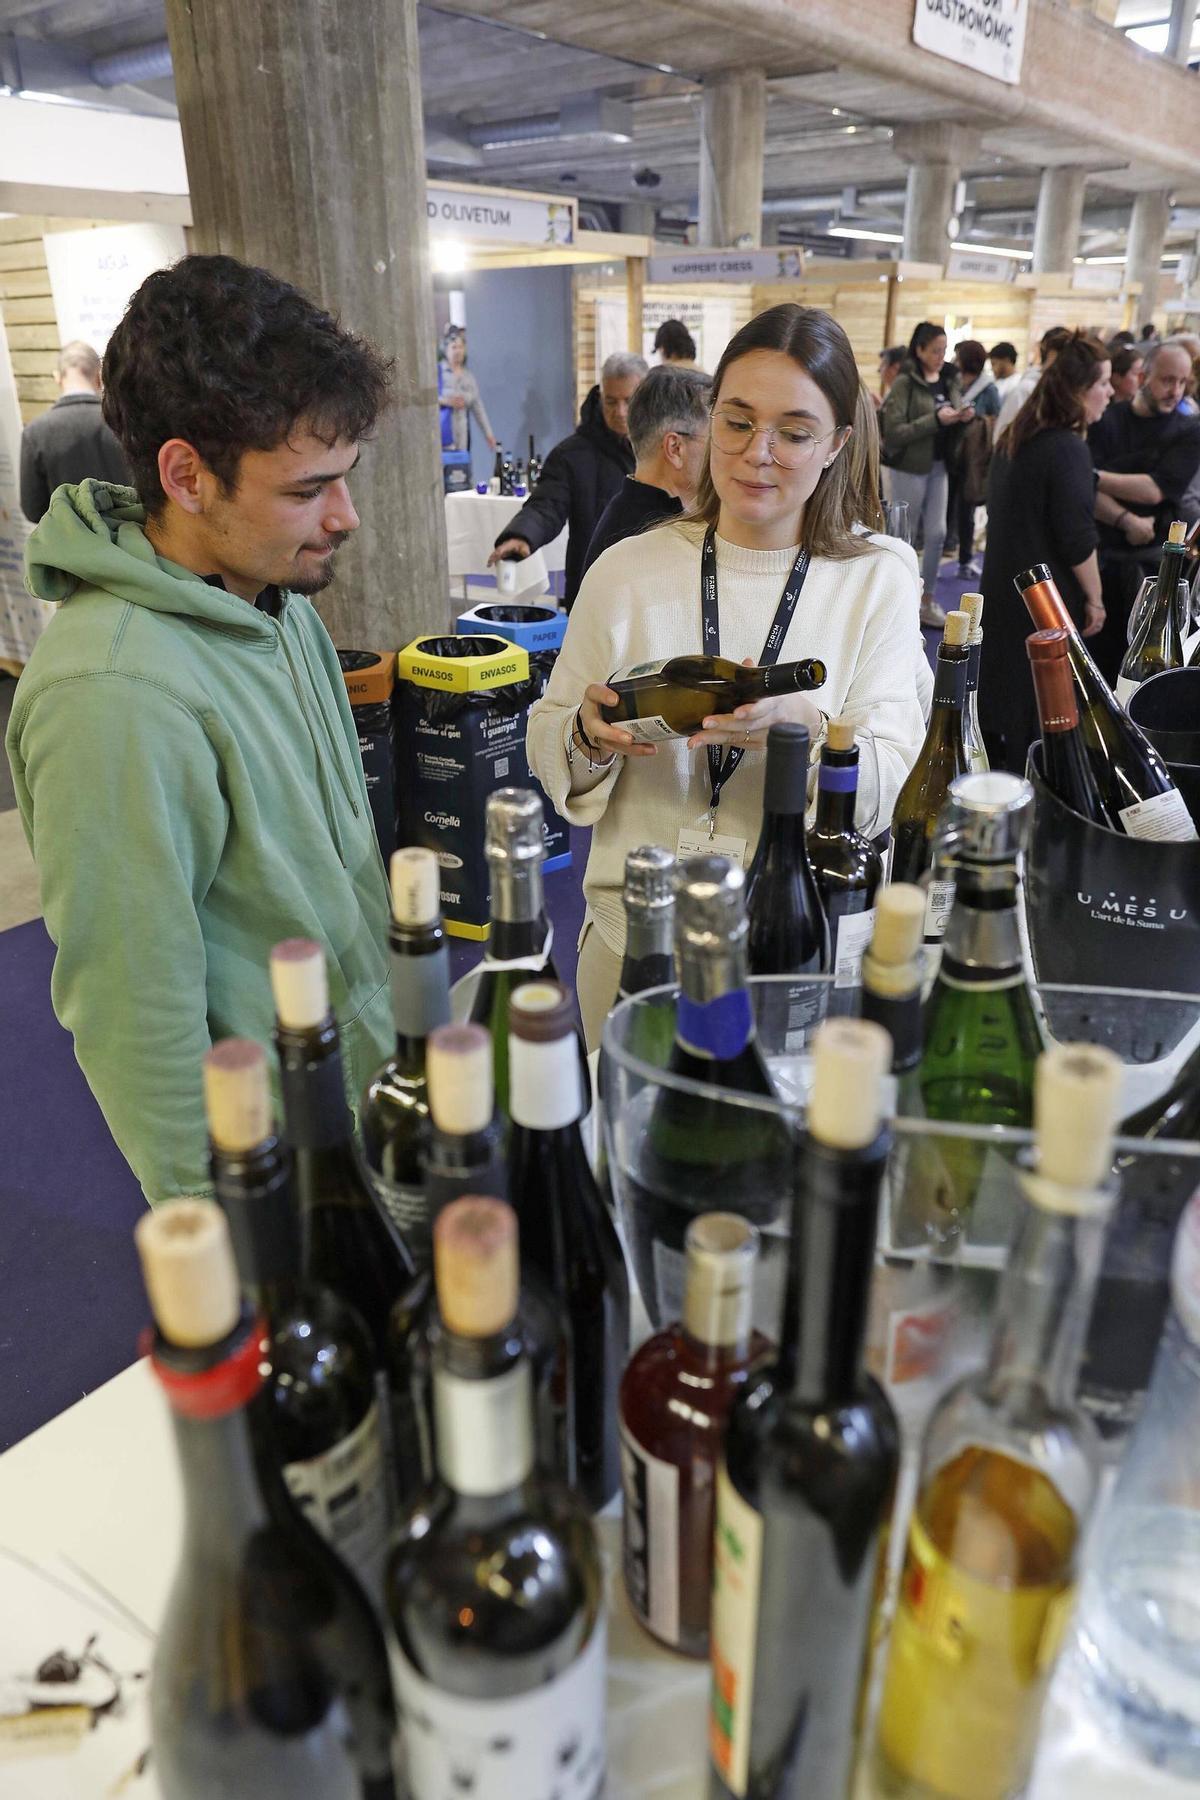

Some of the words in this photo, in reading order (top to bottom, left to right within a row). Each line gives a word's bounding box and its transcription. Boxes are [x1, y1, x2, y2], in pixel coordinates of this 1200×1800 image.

[441, 203, 511, 225] OLIVETUM
[672, 262, 717, 274] KOPPERT
[719, 260, 753, 273] CRESS
[532, 630, 557, 643] PAPER
[411, 666, 453, 682] ENVASOS
[480, 663, 517, 680] ENVASOS
[448, 731, 461, 739] got!
[488, 720, 517, 739] guanya!
[424, 811, 461, 827] Cornellà
[1091, 910, 1112, 922] L'art
[1112, 915, 1125, 925] de
[1126, 917, 1136, 926] la
[1136, 920, 1165, 930] Suma
